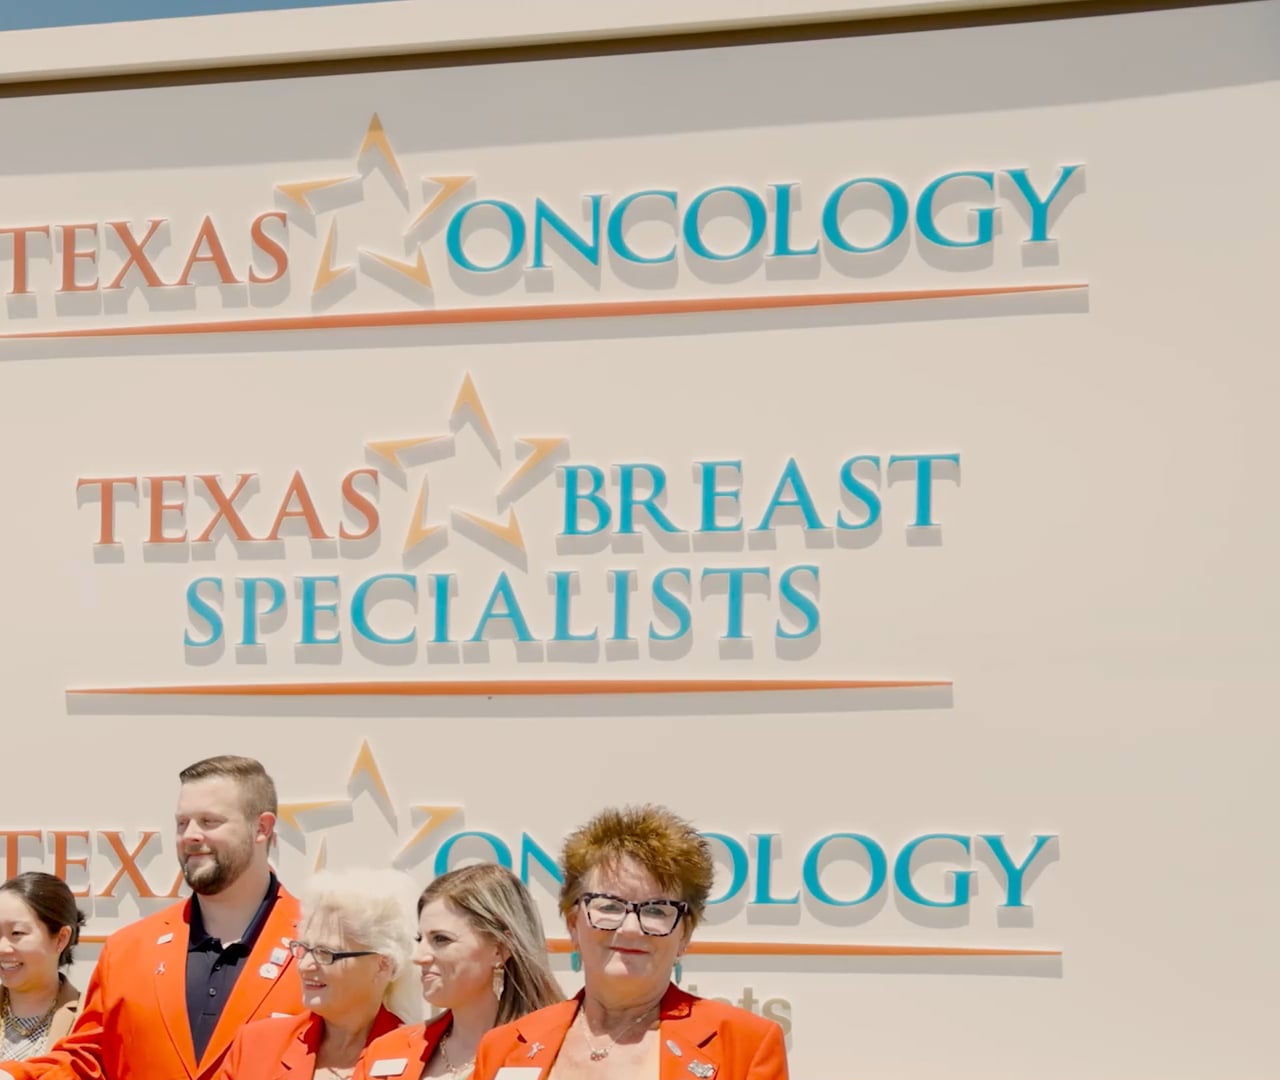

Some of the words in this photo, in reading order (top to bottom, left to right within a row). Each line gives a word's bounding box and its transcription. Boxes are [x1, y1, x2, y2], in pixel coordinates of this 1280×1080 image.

[444, 165, 1078, 273] ONCOLOGY
[77, 468, 380, 546] TEXAS
[560, 453, 961, 537] BREAST
[183, 564, 821, 648] SPECIALISTS
